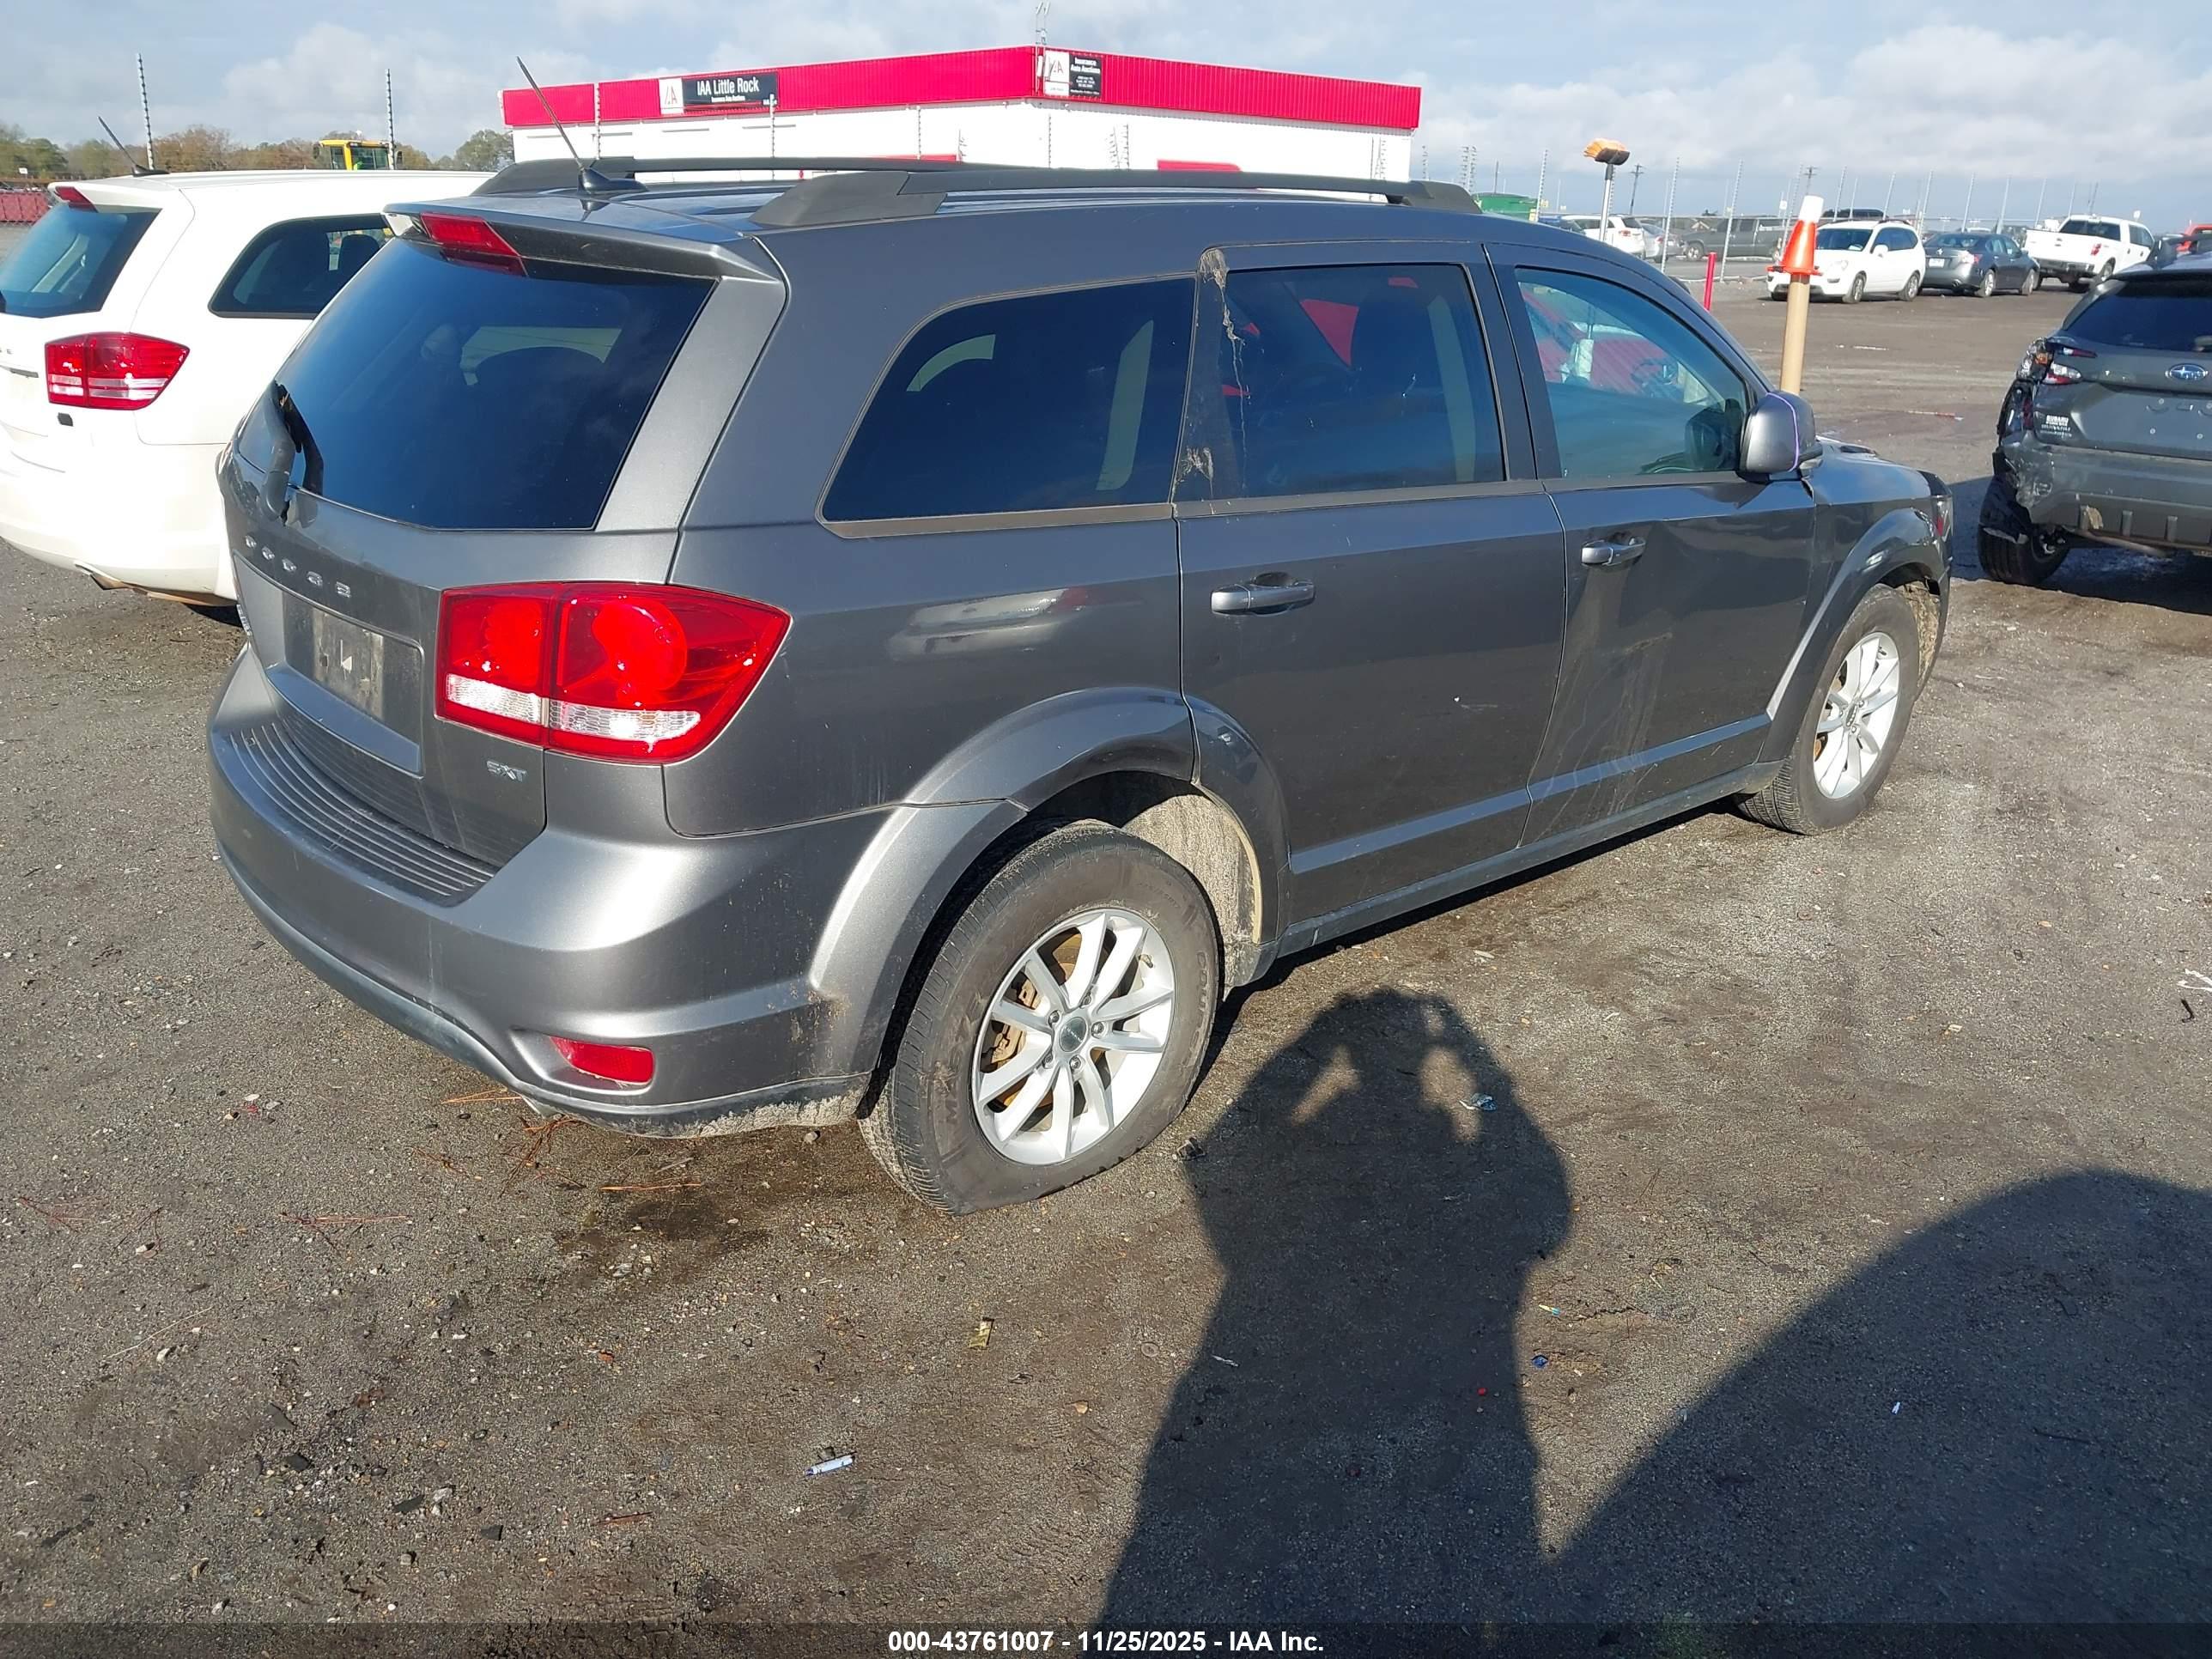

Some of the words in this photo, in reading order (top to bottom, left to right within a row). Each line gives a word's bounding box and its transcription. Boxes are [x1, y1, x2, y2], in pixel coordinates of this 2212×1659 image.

[697, 81, 712, 96] IAA
[714, 78, 735, 94] Little
[737, 76, 760, 93] Rock
[246, 535, 351, 598] DODGE
